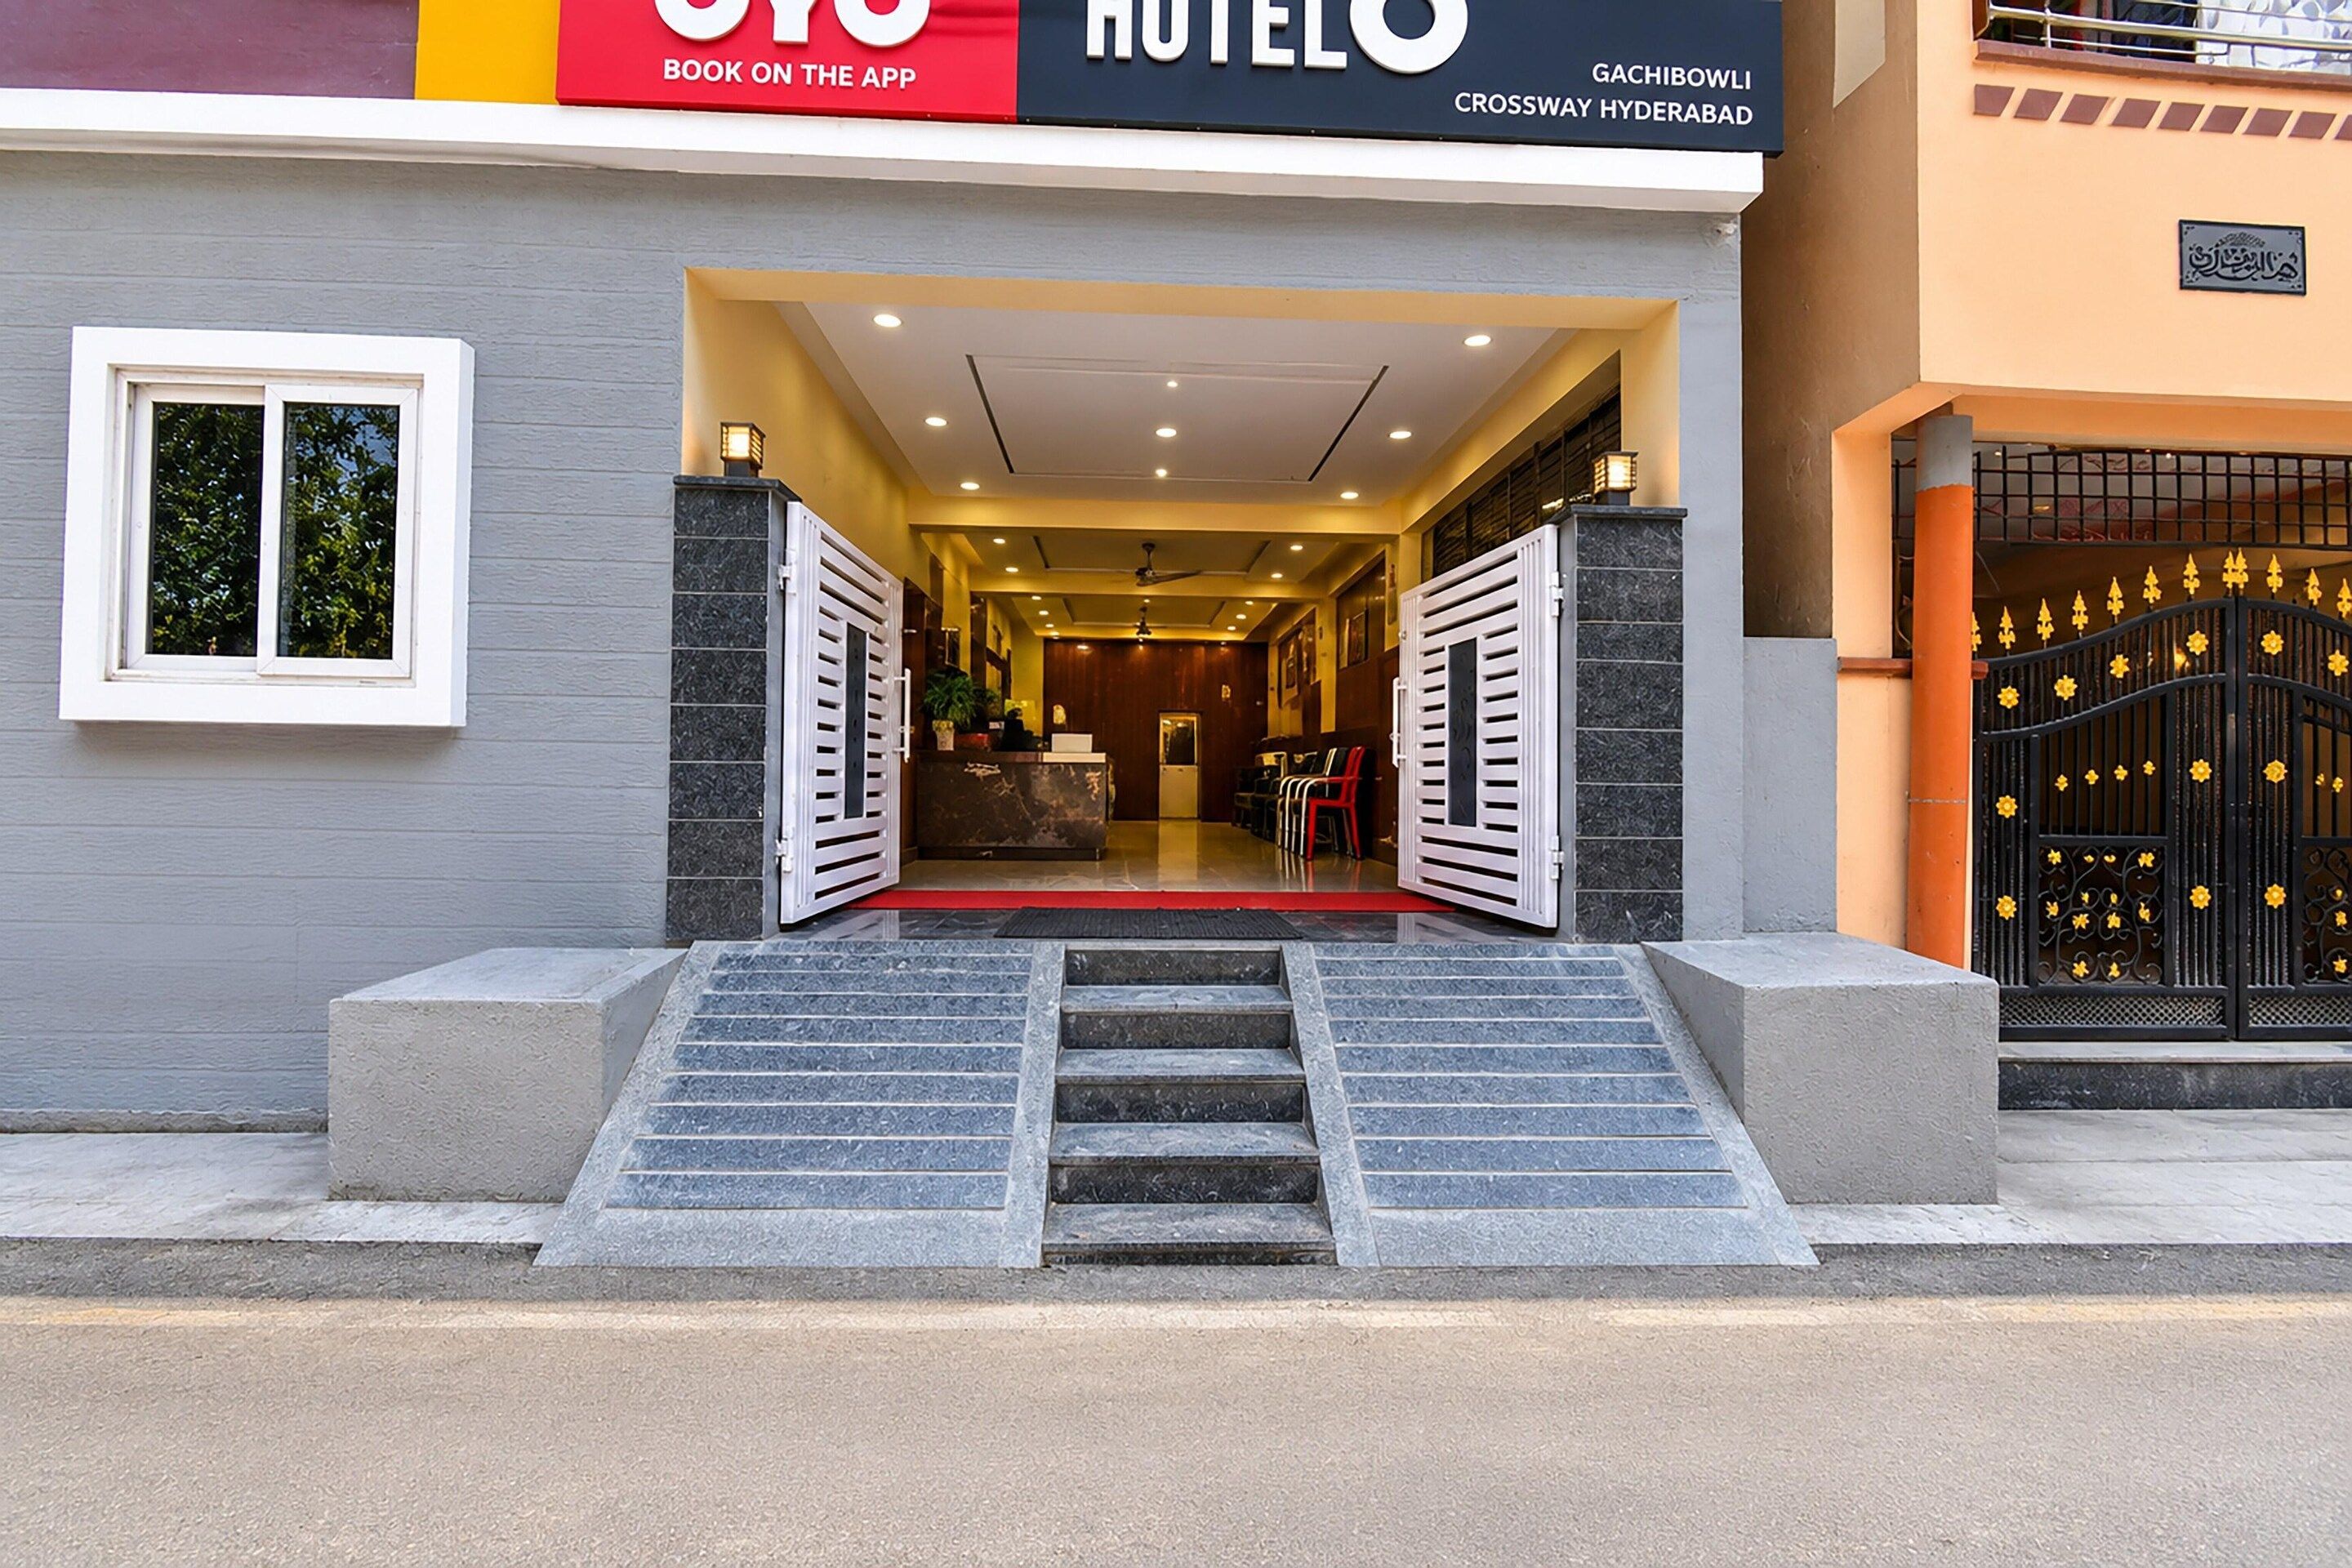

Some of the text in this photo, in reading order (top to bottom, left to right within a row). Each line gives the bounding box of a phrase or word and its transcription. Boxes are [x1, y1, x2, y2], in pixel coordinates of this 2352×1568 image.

[665, 60, 915, 88] BOOK ON THE APP
[1593, 64, 1750, 89] GACHIBOWLI
[1455, 93, 1753, 124] CROSSWAY HYDERABAD
